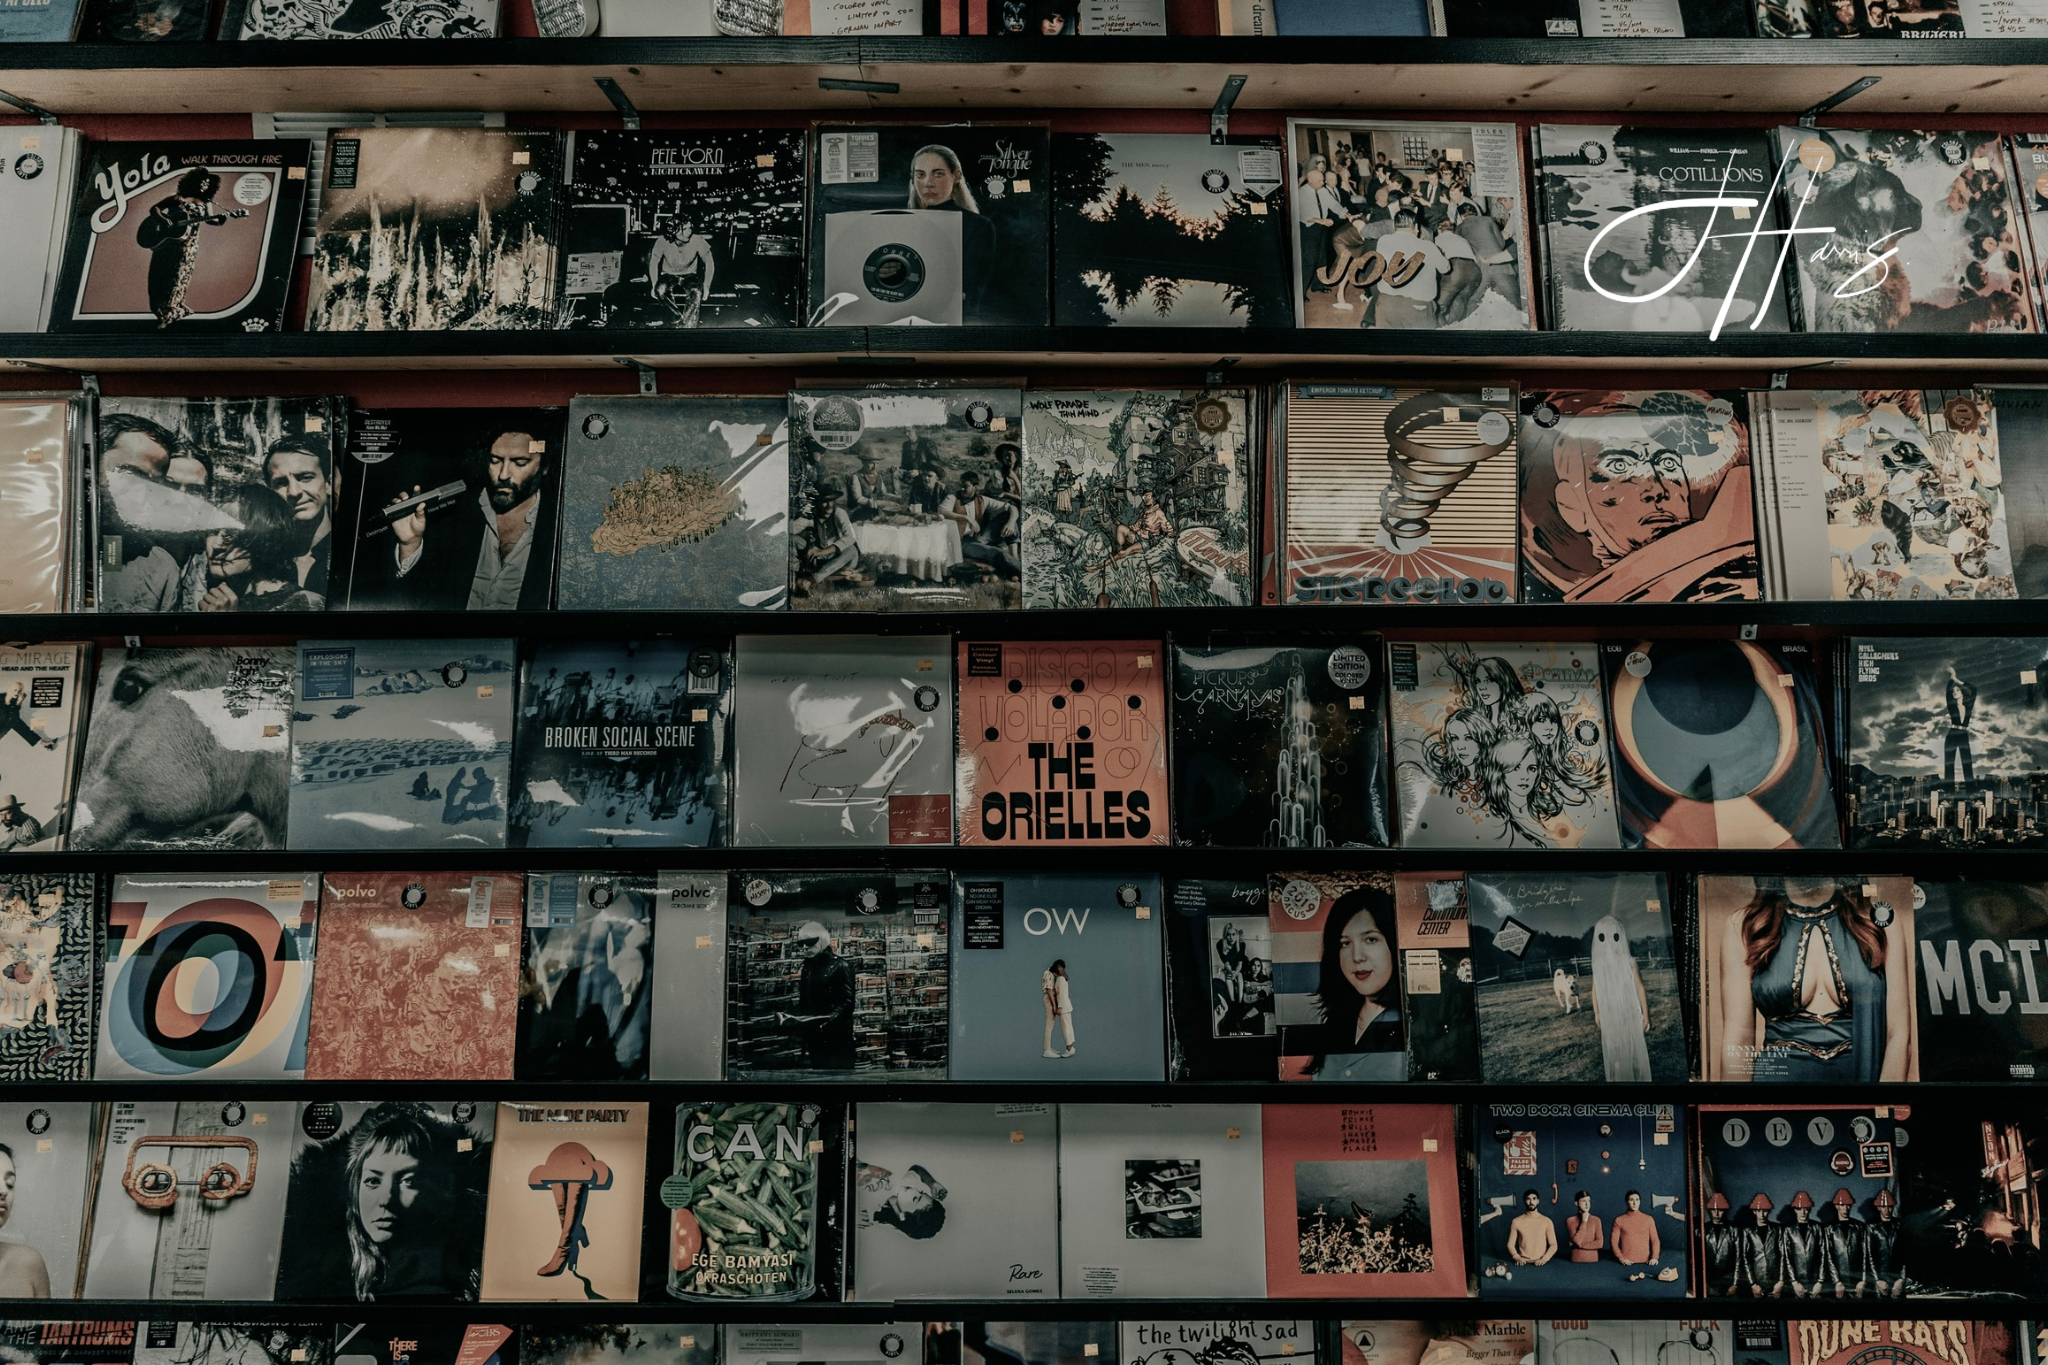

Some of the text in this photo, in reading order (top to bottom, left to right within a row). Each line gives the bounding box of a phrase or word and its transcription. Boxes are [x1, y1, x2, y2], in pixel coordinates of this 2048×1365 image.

[847, 11, 878, 20] LIMITED
[837, 20, 902, 35] GERMAN IMPORT
[651, 148, 724, 164] PETE YORN
[995, 139, 1032, 161] Silver
[181, 154, 283, 165] WALK THROUGH FIRE
[984, 157, 1033, 178] Tongue
[92, 152, 171, 222] Yola
[1359, 387, 1383, 395] KETCHUP
[1030, 400, 1090, 410] WOLF PARADE
[1077, 409, 1100, 418] MIND
[365, 525, 389, 538] Destroyer
[1858, 644, 1875, 652] NOEL
[16, 652, 71, 665] MIRAGE
[236, 656, 269, 667] Bonny
[309, 653, 348, 661] EXPLOSIONS
[1333, 654, 1366, 662] LIMITED
[1004, 647, 1117, 694] DISCO
[1333, 662, 1365, 670] EDITION
[1858, 667, 1880, 675] FLYING
[1858, 674, 1877, 682] BIRDS
[1175, 686, 1285, 720] CARNAVAS
[979, 694, 1148, 742] VOLADOR
[545, 726, 696, 748] BROKEN SOCIAL SCENE
[1028, 742, 1096, 789] THE
[981, 790, 1151, 841] ORIELLES
[338, 884, 377, 901] polvo
[1297, 881, 1319, 902] LUCY
[1288, 886, 1316, 914] 2019
[1283, 896, 1307, 919] DACUS
[1023, 907, 1091, 936] OW
[1417, 922, 1451, 935] CENTER
[517, 1109, 544, 1122] THE
[586, 1109, 630, 1122] PARTY
[1490, 1104, 1525, 1116] TWO
[1527, 1104, 1571, 1116] DOOR
[1573, 1104, 1632, 1116] CINEMA
[687, 1124, 805, 1163] CAN
[691, 1253, 793, 1269] EGE BAMYASI
[696, 1272, 788, 1286] OKRASCHOTEN
[1008, 1263, 1043, 1283] Rare
[1484, 1322, 1526, 1335] Marble
[1552, 1319, 1589, 1330] GOOD
[7, 1331, 36, 1345] THE
[1137, 1320, 1298, 1345] the twilight sad
[389, 1340, 418, 1351] THERE
[393, 1351, 401, 1361] IS
[1466, 1346, 1511, 1359] Bigger Than
